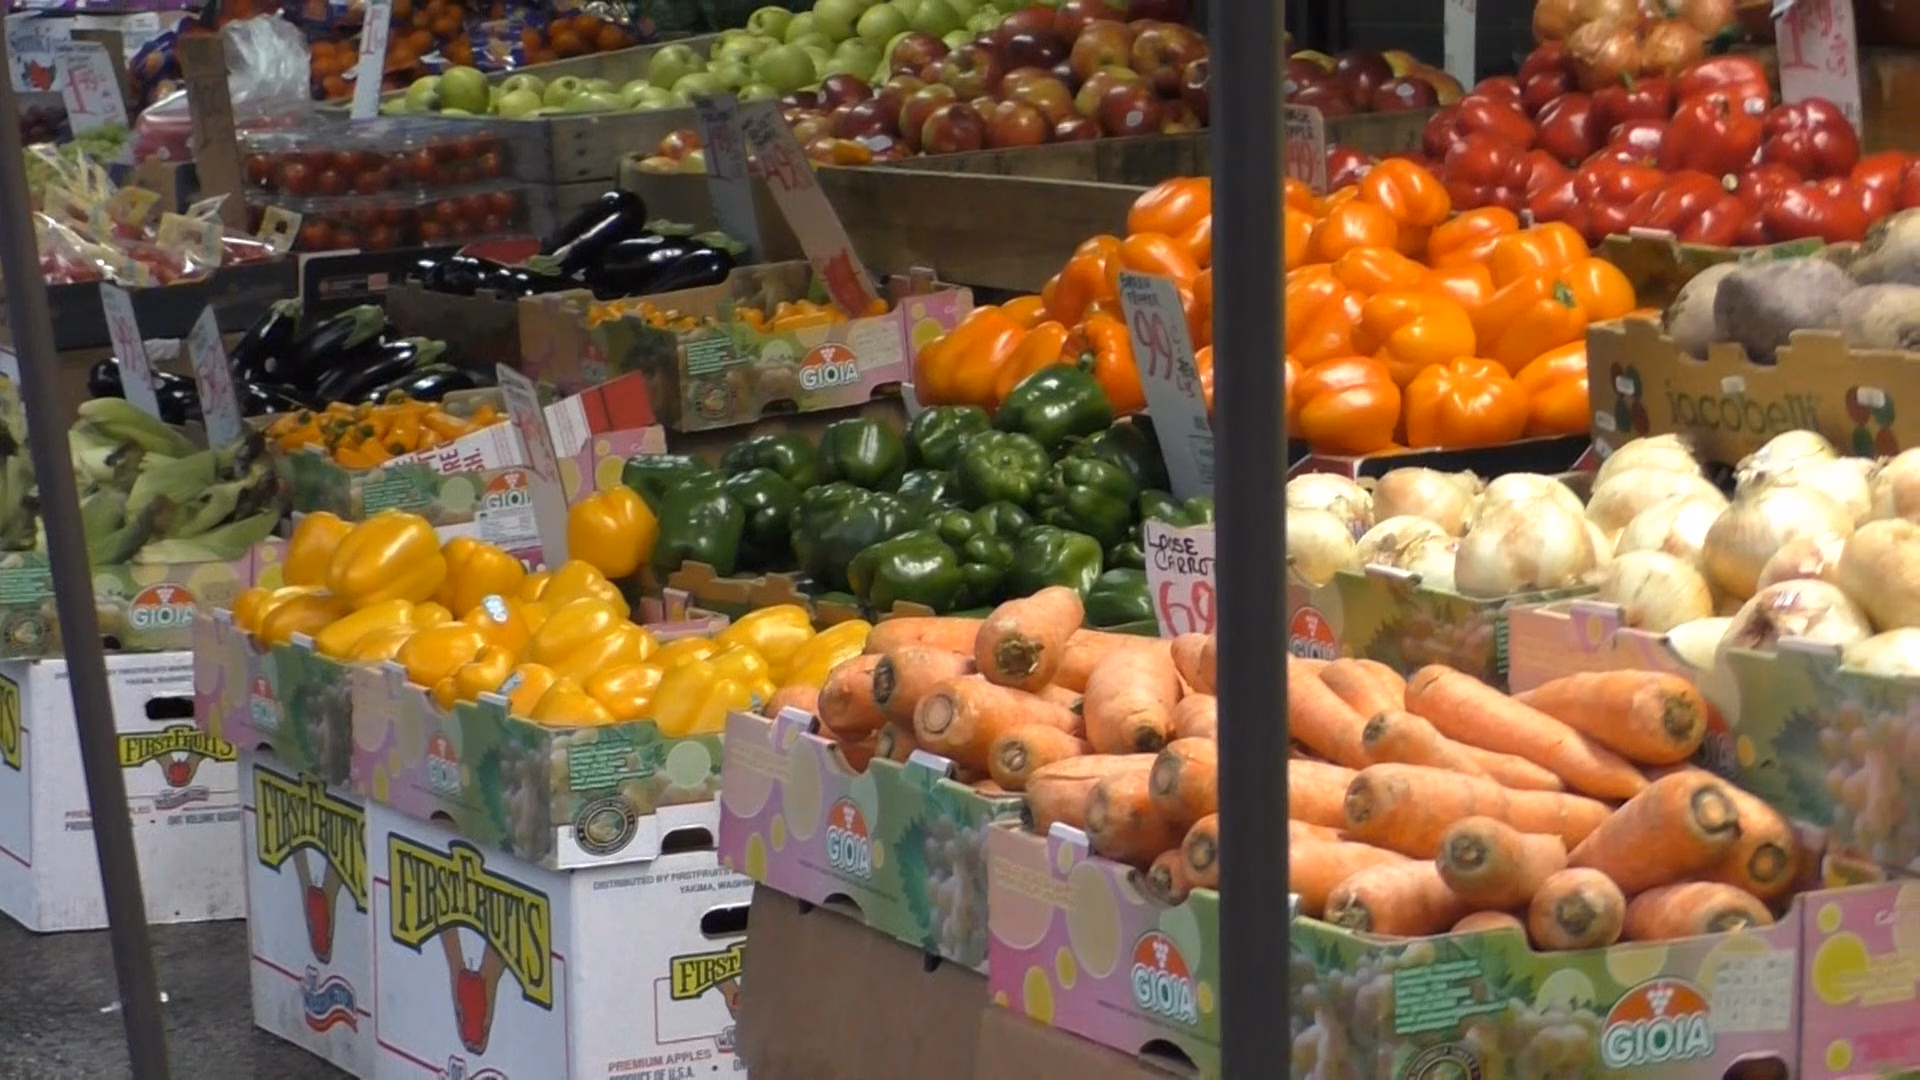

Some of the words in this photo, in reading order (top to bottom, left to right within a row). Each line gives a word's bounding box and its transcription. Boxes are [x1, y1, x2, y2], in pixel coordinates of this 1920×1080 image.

[799, 361, 860, 391] GIOIA
[484, 490, 533, 510] GIOI
[1155, 551, 1216, 575] CARRO
[827, 826, 873, 880] GIOIA
[397, 849, 546, 989] FIRSTFRUITS
[1131, 964, 1197, 1025] GIOIA
[609, 1055, 663, 1072] PREMIUM
[665, 1049, 712, 1065] APPLES
[1602, 1012, 1714, 1068] GIOIA
